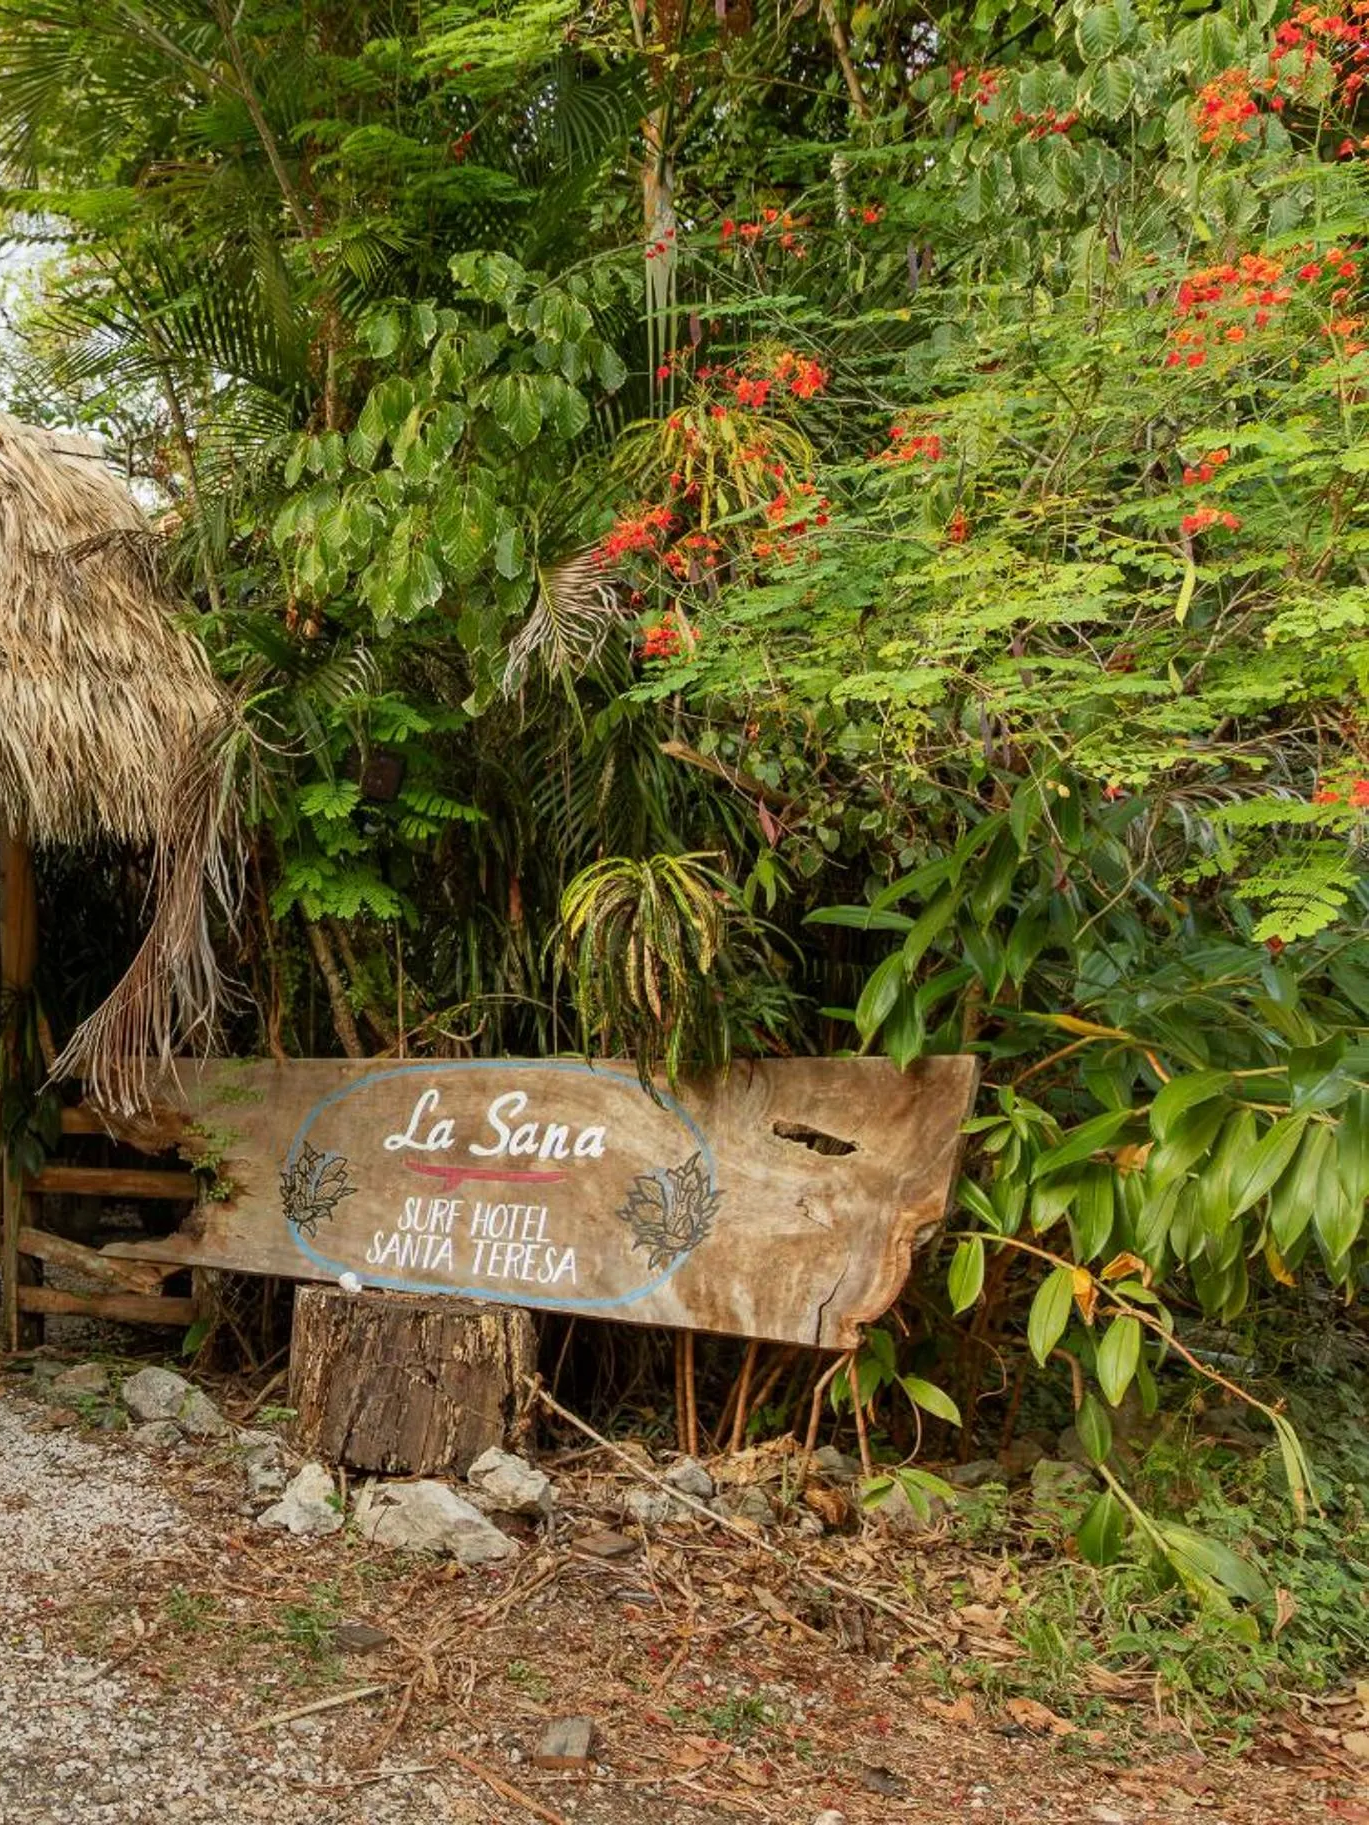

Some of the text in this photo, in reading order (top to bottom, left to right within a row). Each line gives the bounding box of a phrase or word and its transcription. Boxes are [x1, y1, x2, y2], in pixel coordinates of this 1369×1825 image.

[383, 1088, 606, 1161] La Sana
[397, 1197, 551, 1242] SURF HOTEL
[365, 1230, 577, 1286] SANTA TERESA
